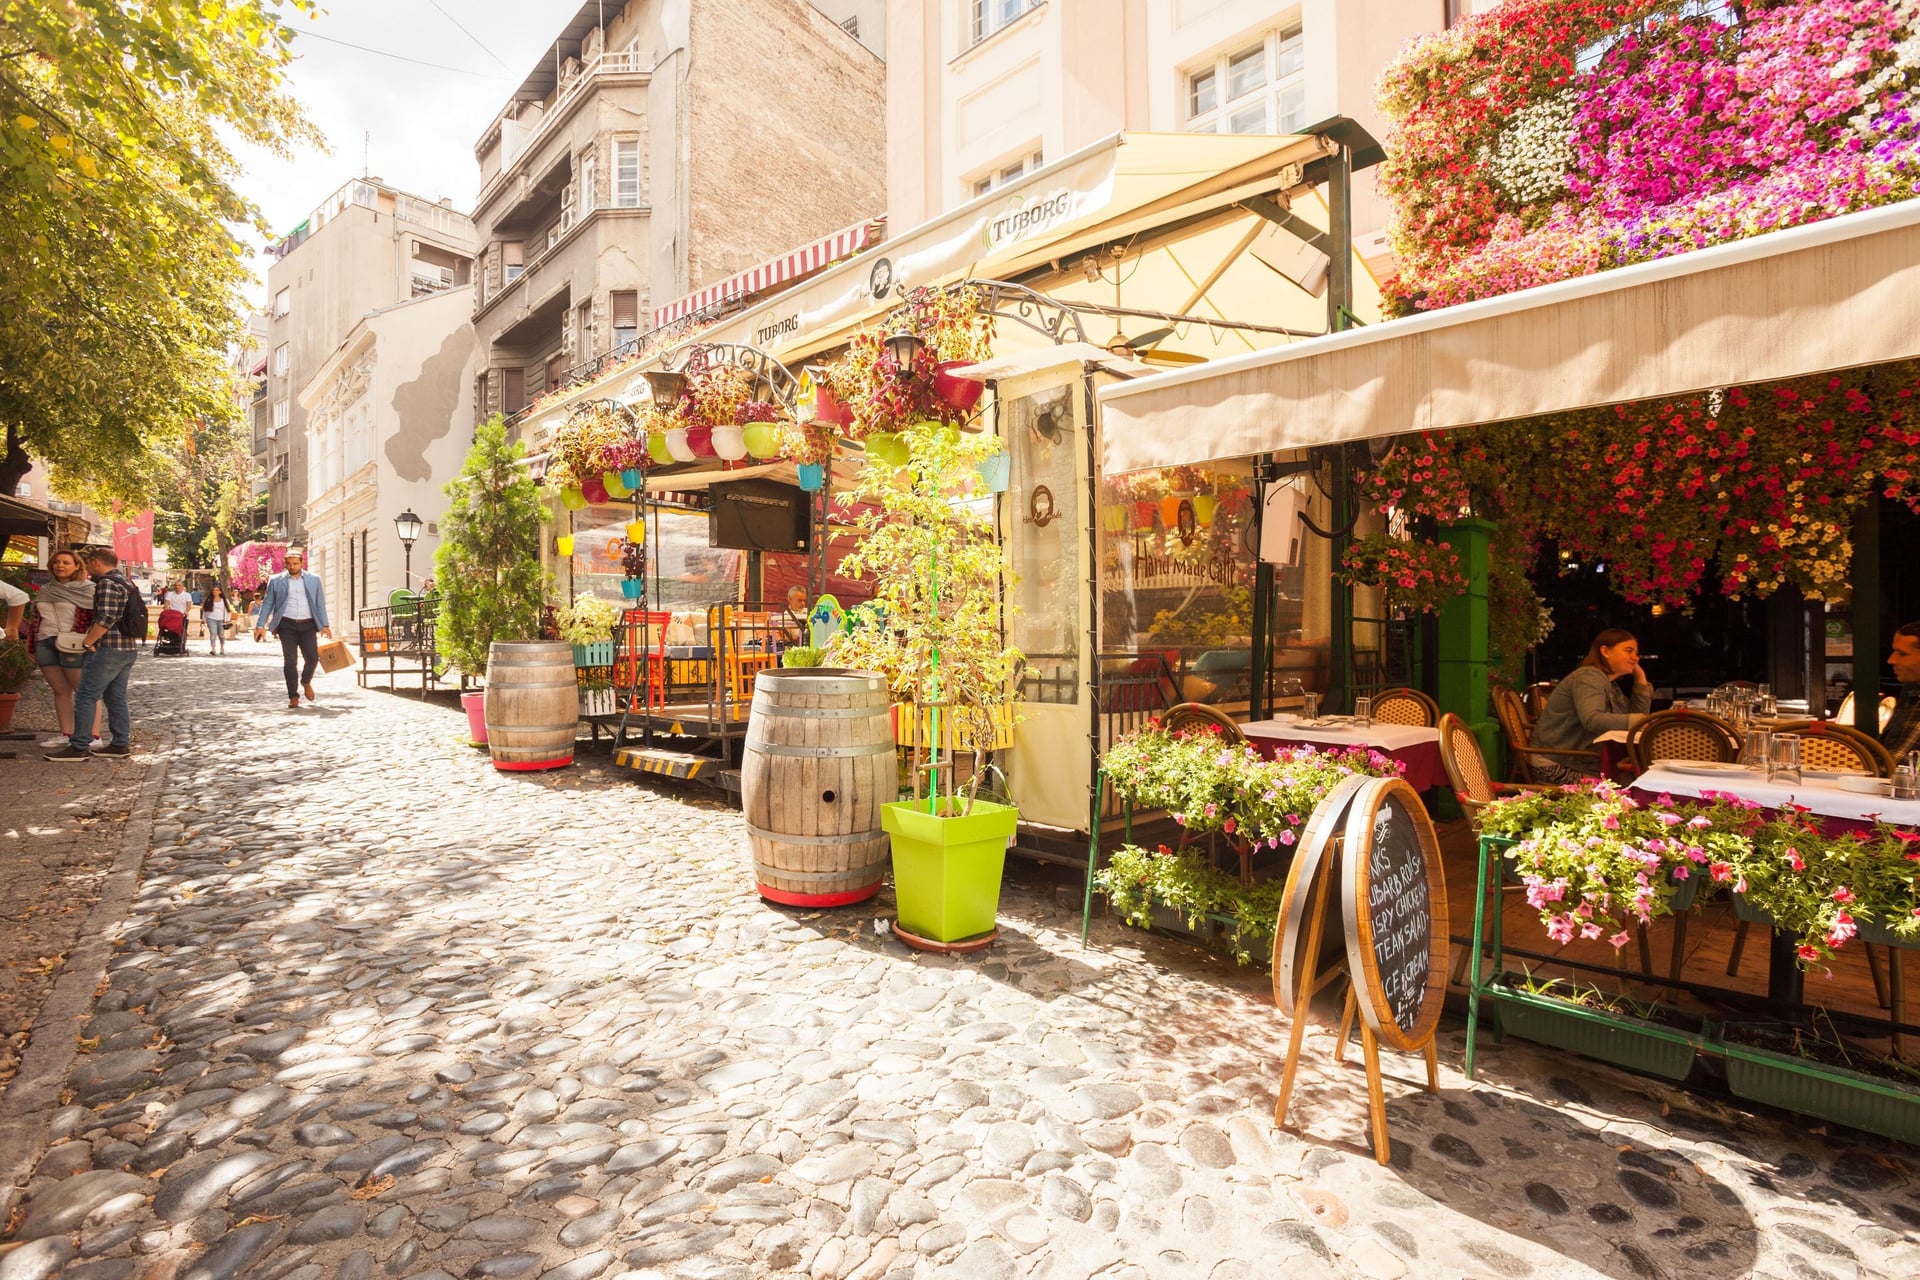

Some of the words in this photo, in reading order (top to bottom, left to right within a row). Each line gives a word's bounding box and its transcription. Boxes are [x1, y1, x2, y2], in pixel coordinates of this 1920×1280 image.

[993, 192, 1068, 242] TUBORG
[758, 314, 799, 345] TUBORG
[1134, 532, 1169, 580] Hand
[1173, 559, 1206, 577] Made
[1404, 948, 1429, 981] CREAM
